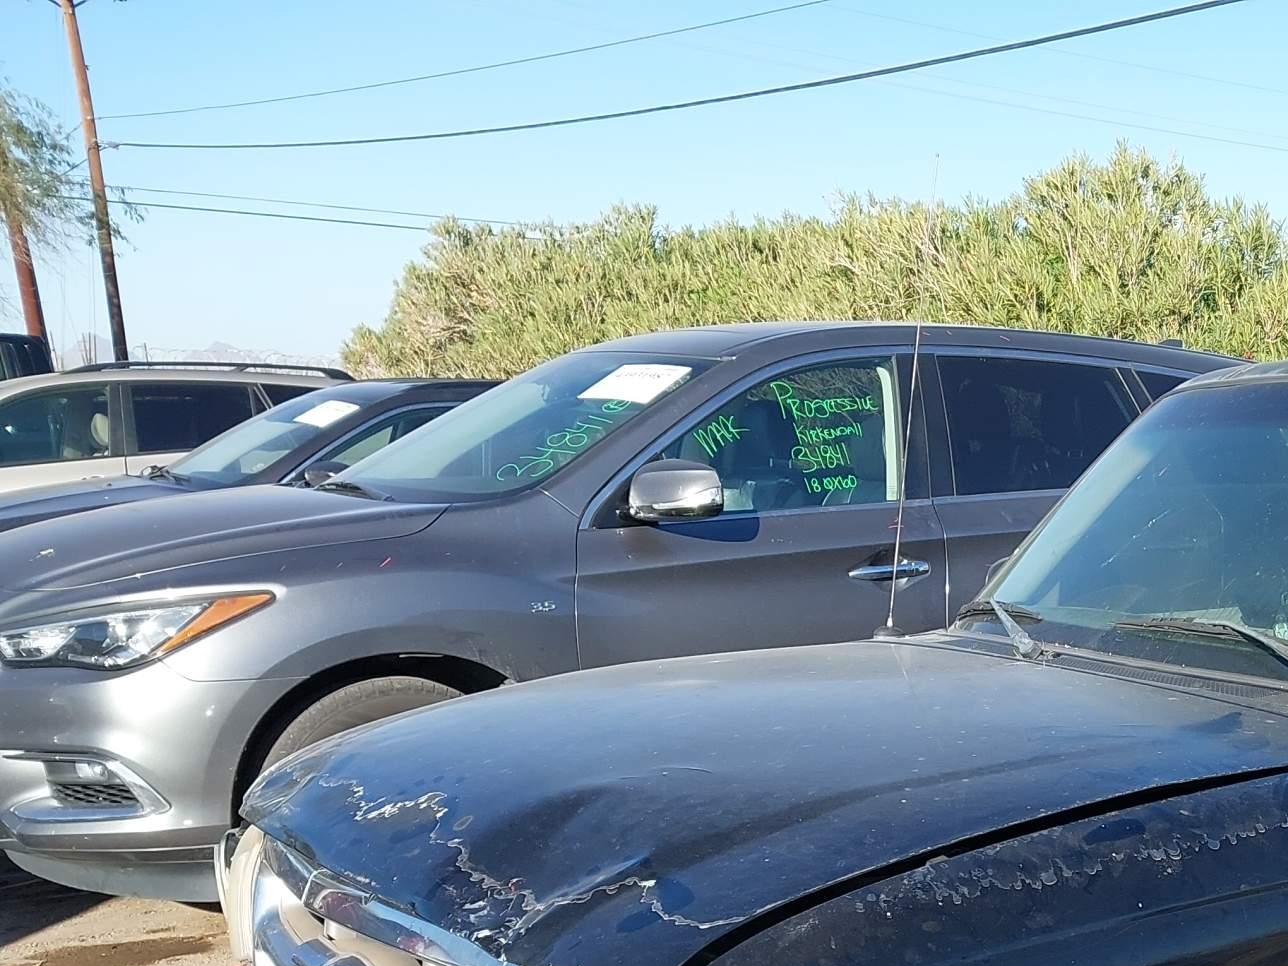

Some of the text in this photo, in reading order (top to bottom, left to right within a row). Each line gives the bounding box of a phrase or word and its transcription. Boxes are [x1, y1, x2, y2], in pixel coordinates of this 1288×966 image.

[496, 416, 613, 481] 34841
[791, 442, 850, 473] 34841
[803, 476, 822, 494] 18
